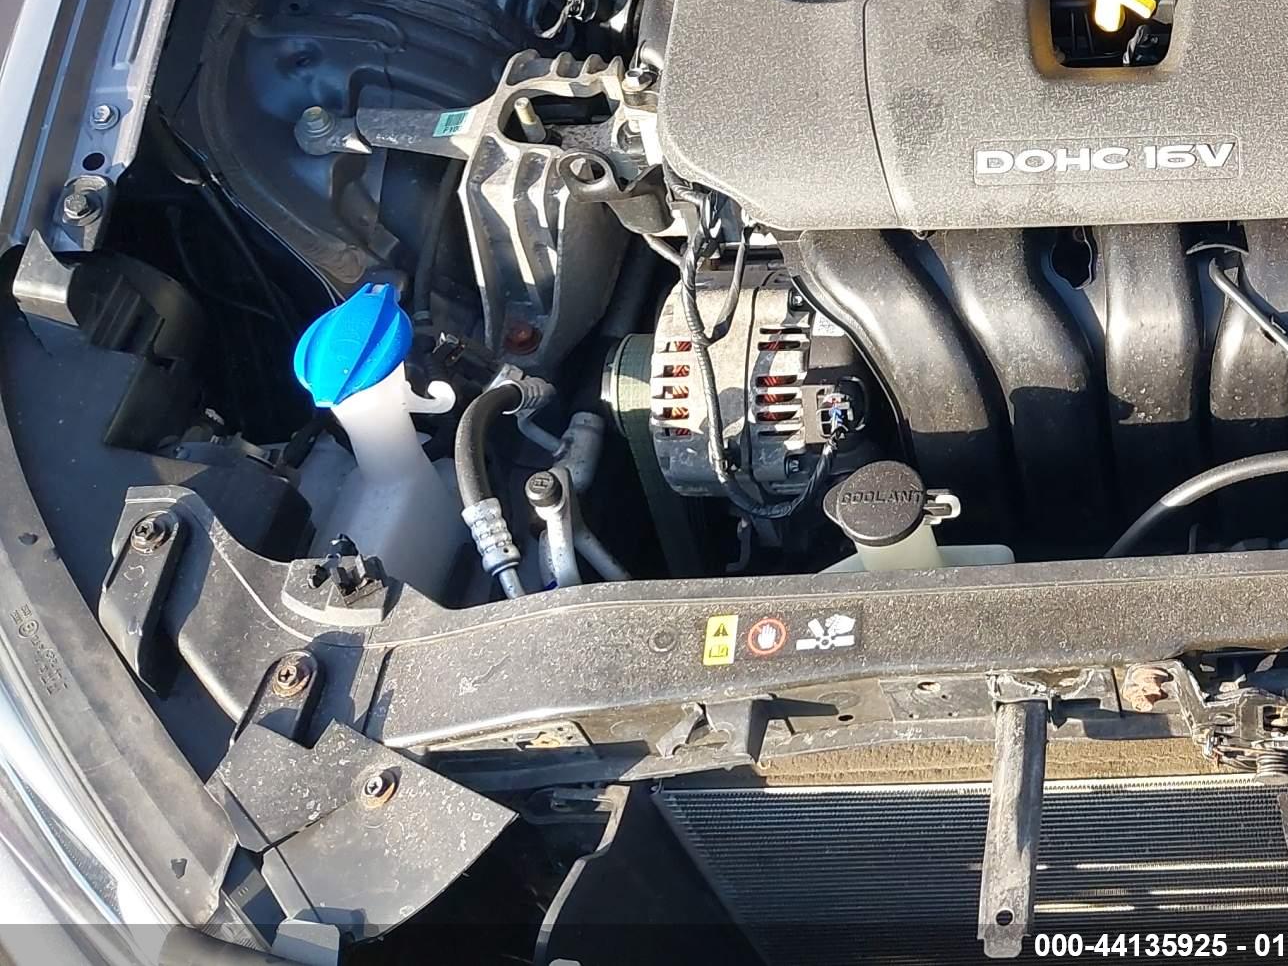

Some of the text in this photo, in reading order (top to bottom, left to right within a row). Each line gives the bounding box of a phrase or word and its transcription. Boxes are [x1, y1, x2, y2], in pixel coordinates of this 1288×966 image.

[976, 141, 1237, 174] DOHC 16V
[840, 490, 923, 506] COOLANT
